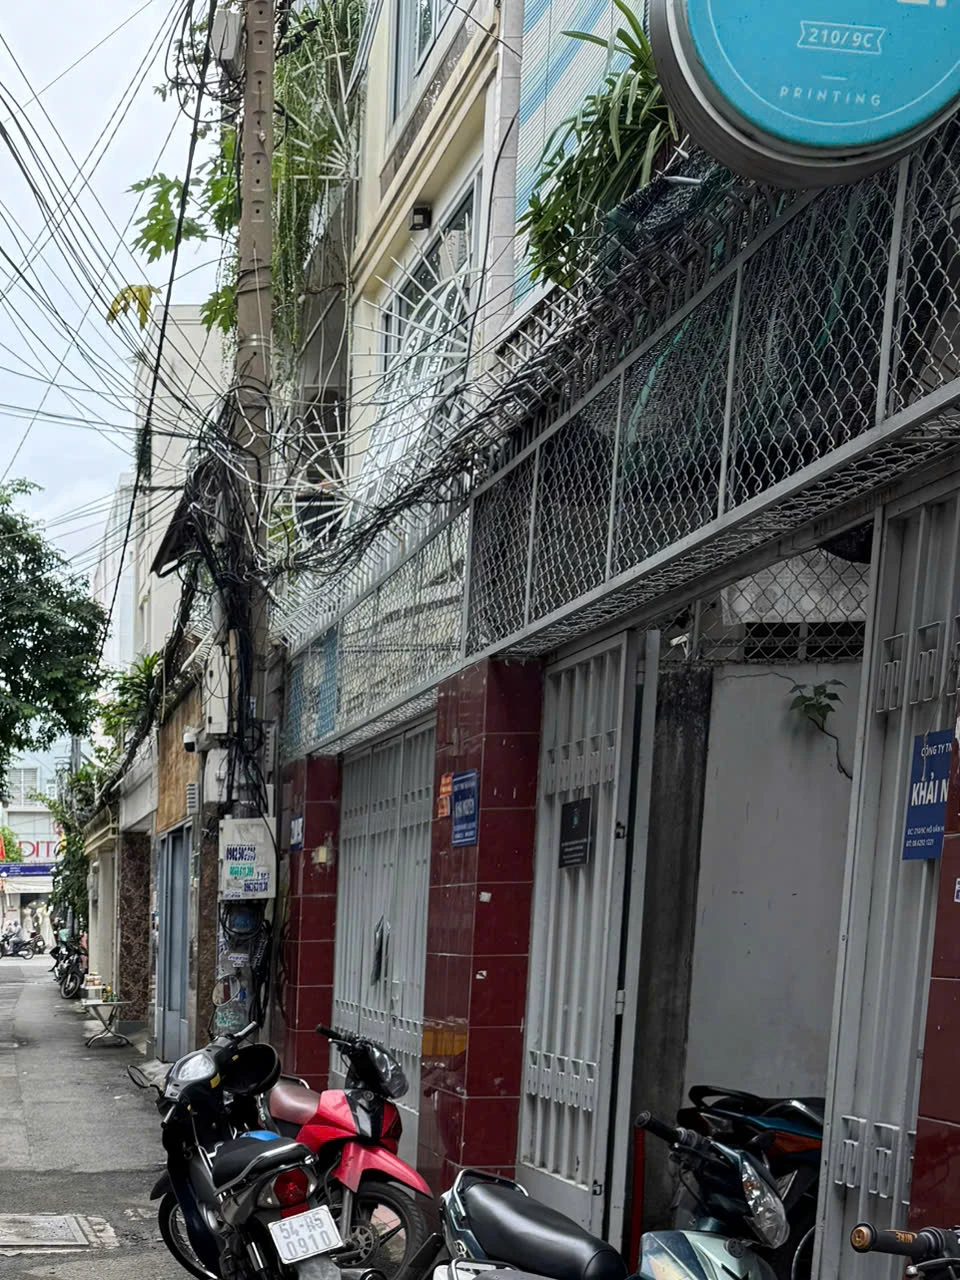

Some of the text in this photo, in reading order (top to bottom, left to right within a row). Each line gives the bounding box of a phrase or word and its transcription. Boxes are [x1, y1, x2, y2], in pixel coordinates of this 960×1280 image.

[808, 28, 875, 49] 210/9C
[780, 86, 881, 107] PRINTING
[921, 744, 937, 757] CÔNG
[938, 744, 945, 754] TY
[911, 771, 939, 806] KHẢI
[286, 1230, 332, 1257] 0910
